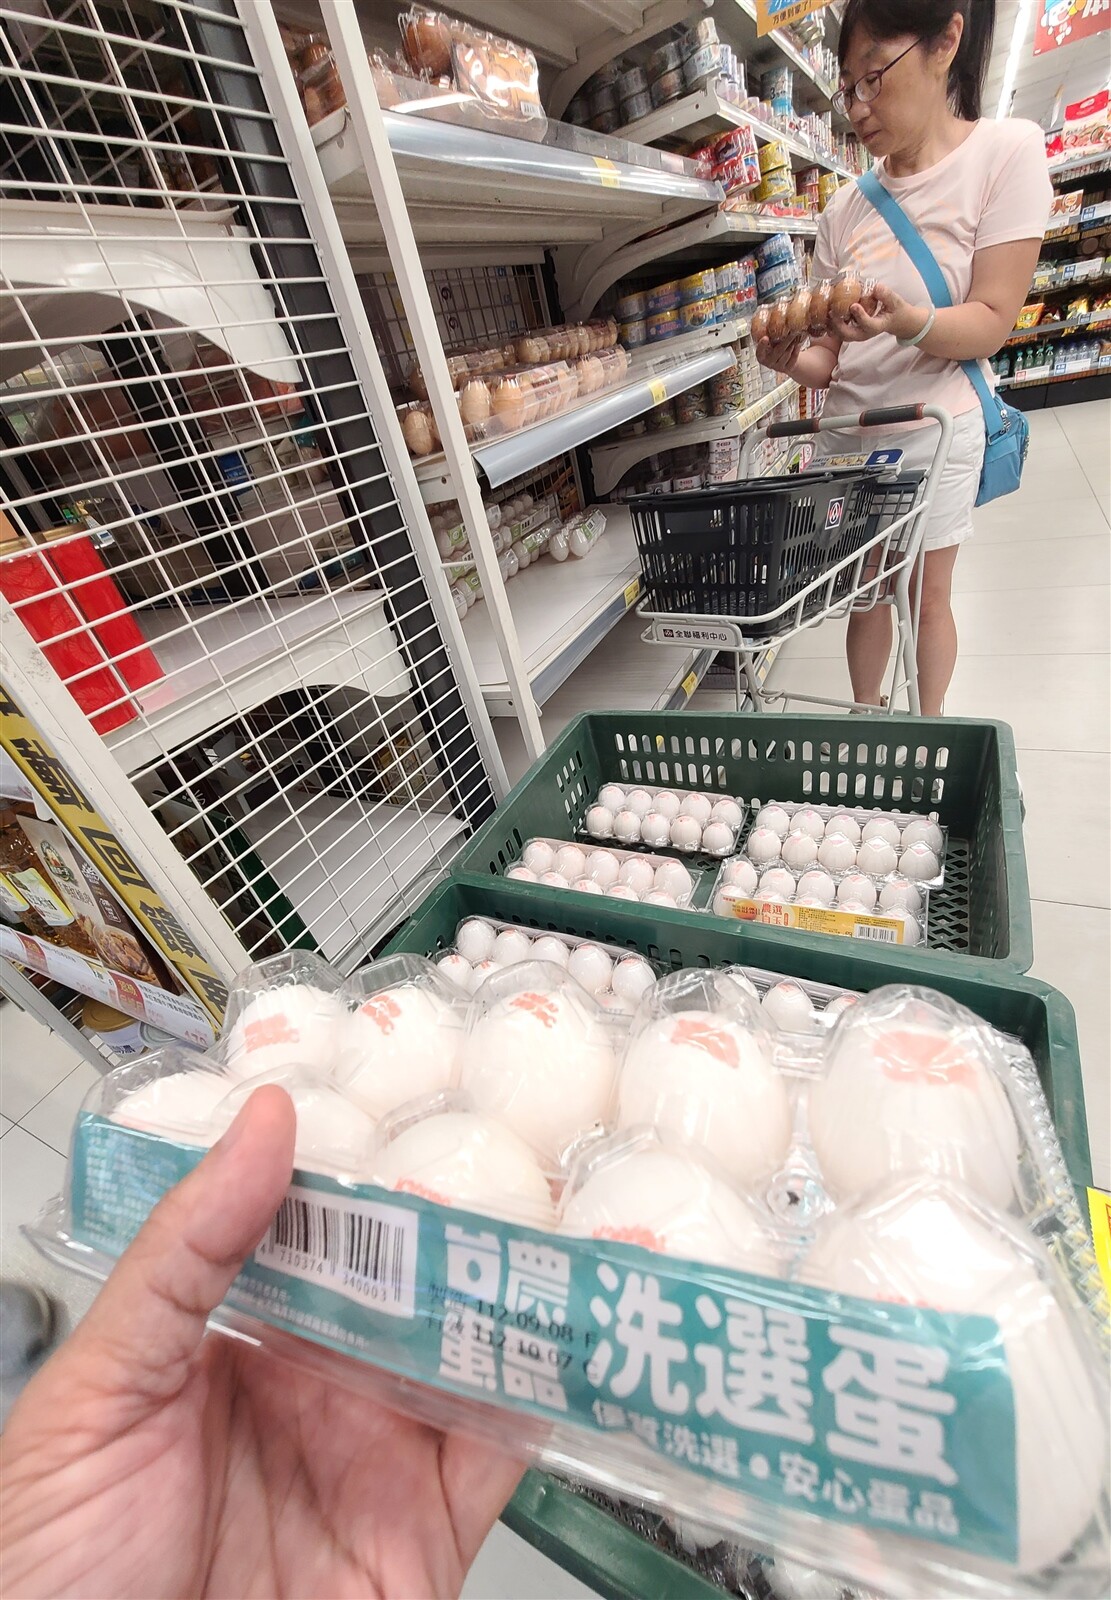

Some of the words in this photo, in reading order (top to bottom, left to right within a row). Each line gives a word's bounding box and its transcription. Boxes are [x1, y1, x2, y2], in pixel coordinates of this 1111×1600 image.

[675, 630, 727, 641] 全聯福利中心
[761, 903, 783, 916] 農選
[279, 1250, 323, 1275] 710374
[342, 1271, 388, 1303] 340003
[477, 1299, 573, 1343] 112.09.08
[588, 1263, 958, 1485] 洗選蛋
